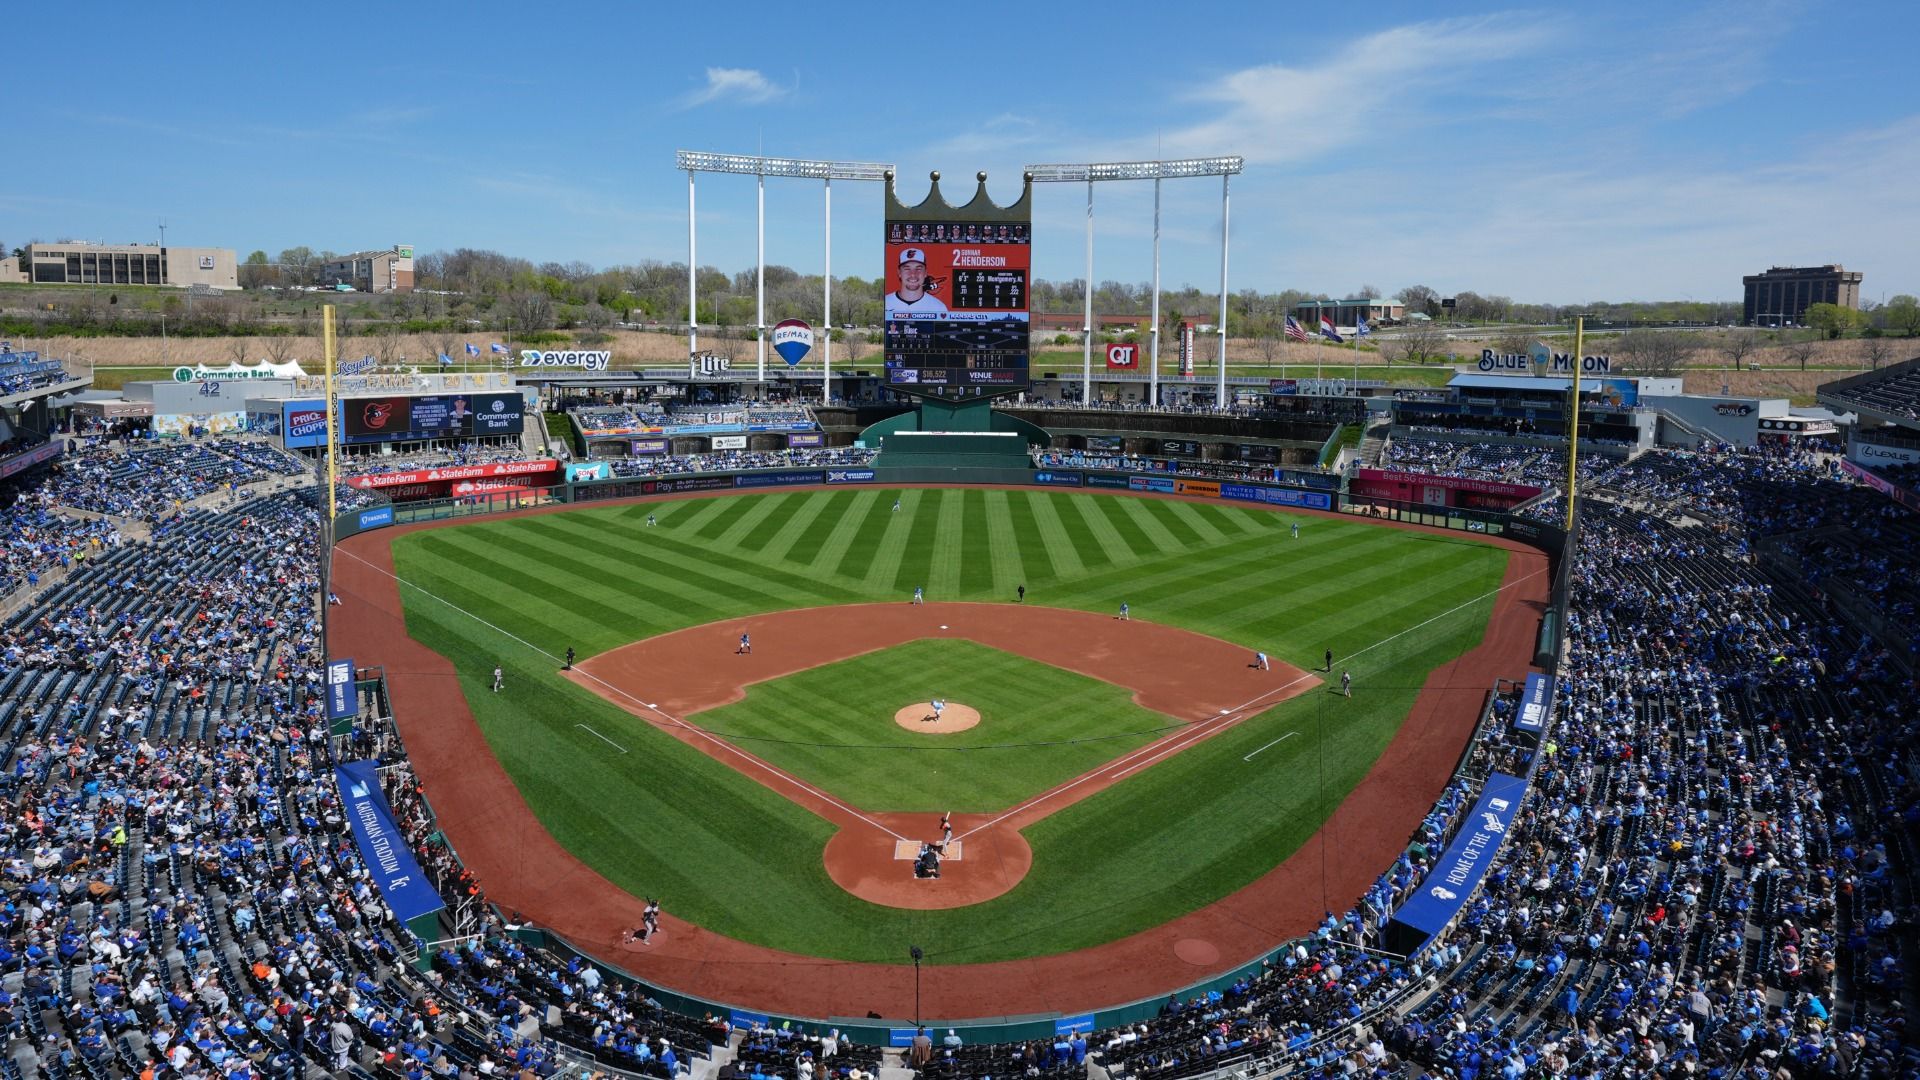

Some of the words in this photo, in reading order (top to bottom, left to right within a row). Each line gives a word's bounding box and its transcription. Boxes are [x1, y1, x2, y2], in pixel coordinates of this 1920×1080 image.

[952, 249, 961, 266] 2
[962, 256, 1006, 266] HENDERSON
[777, 331, 808, 340] RE/MAX
[544, 352, 608, 369] evergy
[1109, 347, 1133, 365] QT
[1478, 350, 1528, 371] BLUE
[336, 356, 376, 376] Royals
[700, 356, 730, 375] Lite
[196, 370, 248, 378] Commerce
[252, 369, 275, 378] Bank
[200, 382, 220, 394] 42
[367, 374, 415, 389] FAME
[1298, 380, 1346, 396] PATIO
[938, 387, 942, 395] 0
[959, 387, 964, 395] 0
[976, 387, 981, 395] 0
[1271, 385, 1296, 394] CHOPPER
[293, 412, 321, 425] PRICE
[477, 412, 519, 421] Commerce
[1063, 456, 1120, 467] FOUNTAIN
[1123, 458, 1153, 469] DECK
[1874, 450, 1910, 461] LEXUS
[656, 482, 672, 492] Pay
[1383, 472, 1401, 481] Best
[1404, 474, 1416, 483] 5G
[1418, 477, 1459, 488] coverage
[1472, 482, 1487, 491] the
[1489, 484, 1515, 494] game
[333, 664, 348, 683] UMB
[1521, 703, 1542, 725] UMB
[355, 800, 380, 839] KAUFFMAN
[373, 838, 401, 875] STADIUM
[389, 876, 410, 892] KC
[1471, 833, 1491, 849] THE
[1462, 847, 1481, 861] OF
[1445, 862, 1472, 886] HOME
